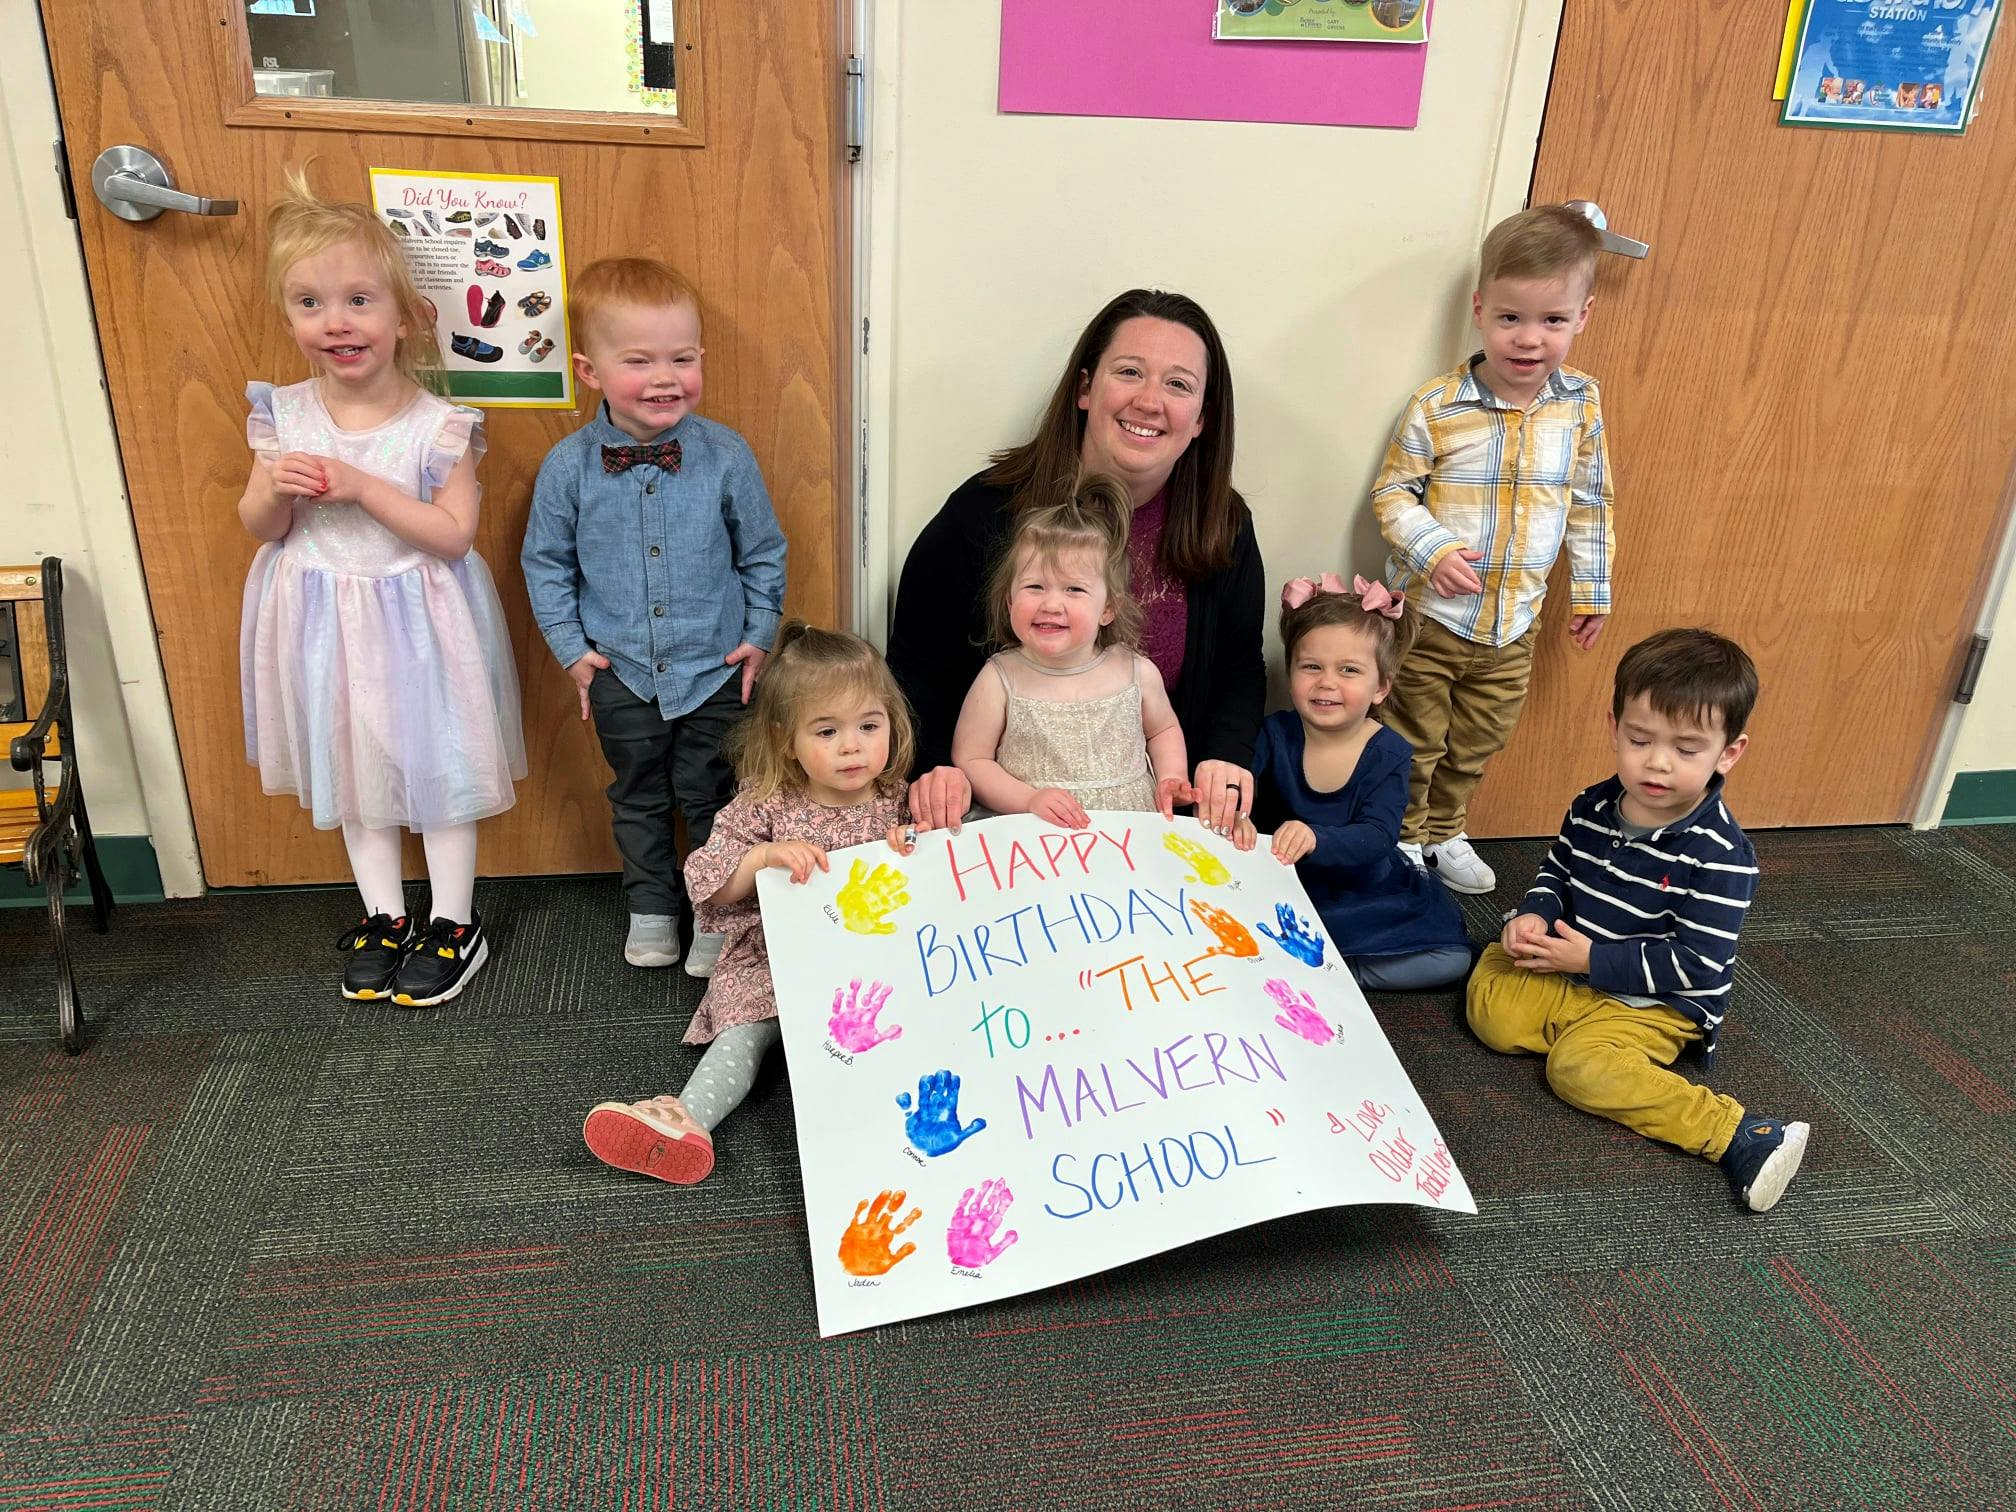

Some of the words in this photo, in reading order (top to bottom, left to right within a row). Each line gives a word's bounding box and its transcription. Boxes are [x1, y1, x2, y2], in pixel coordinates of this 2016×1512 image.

[1869, 7, 1927, 21] STATION
[403, 188, 432, 206] Did
[437, 189, 469, 209] You
[475, 190, 527, 209] Know?
[946, 828, 1136, 901] HAPPY
[916, 887, 1194, 998] BIRTHDAY
[1015, 1033, 1288, 1140] MALVERN
[1368, 1127, 1416, 1183] Older
[1416, 1138, 1452, 1204] Toddlers
